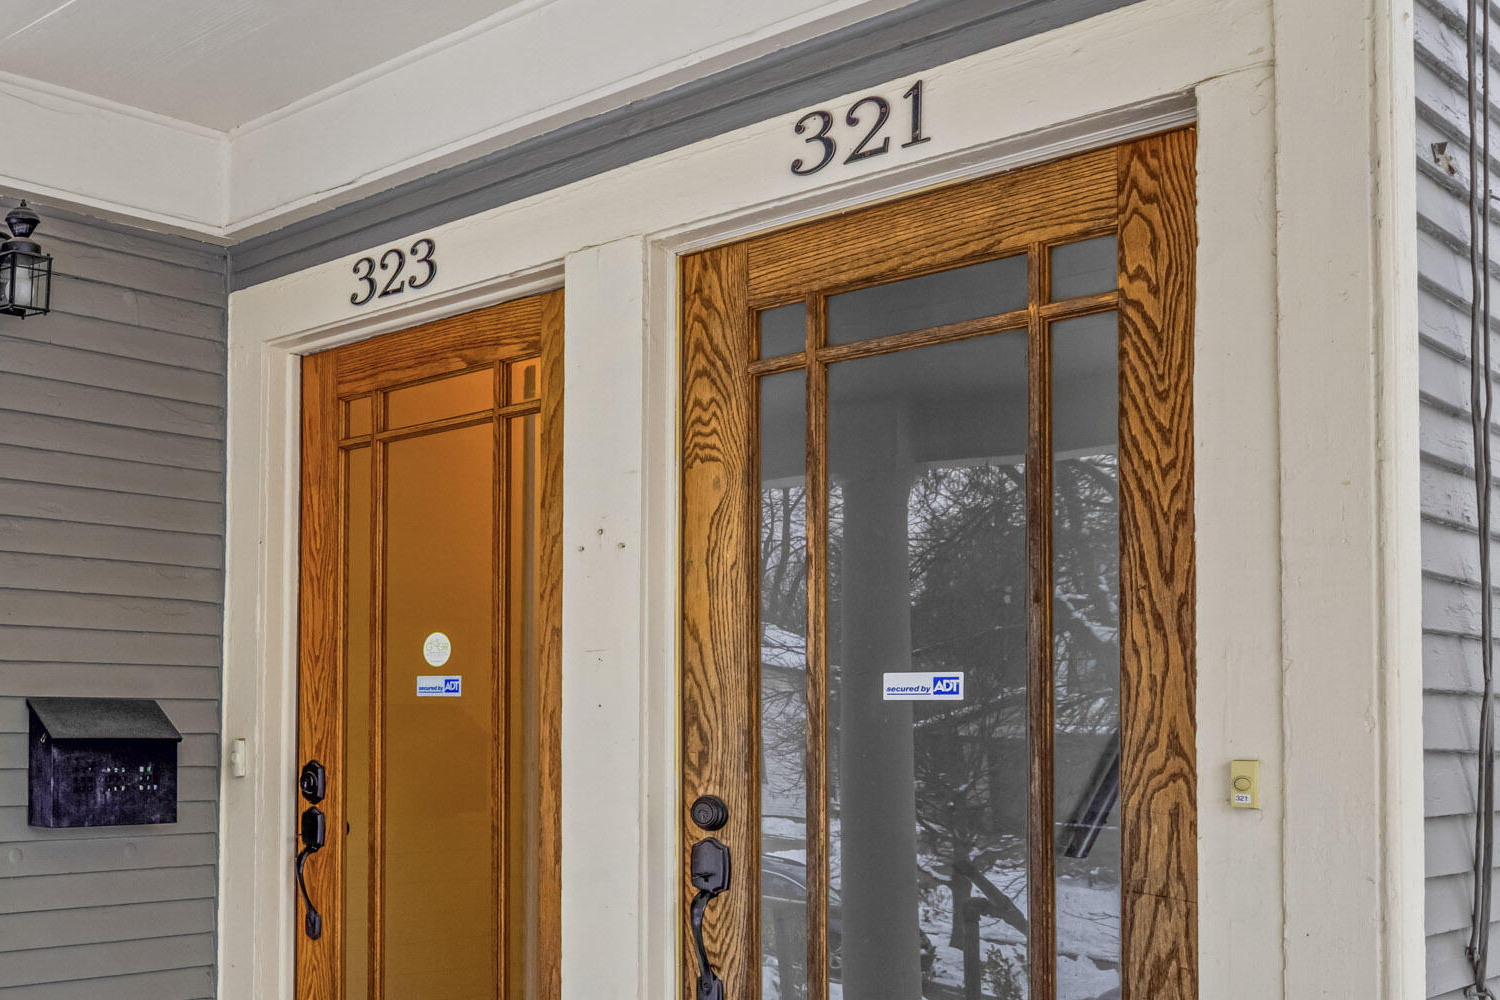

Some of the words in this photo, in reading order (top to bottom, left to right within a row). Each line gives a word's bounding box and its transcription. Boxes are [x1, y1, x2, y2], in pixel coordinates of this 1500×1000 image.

[791, 79, 931, 176] 321
[350, 238, 438, 306] 323
[445, 680, 459, 692] ADT
[933, 679, 960, 693] ADT
